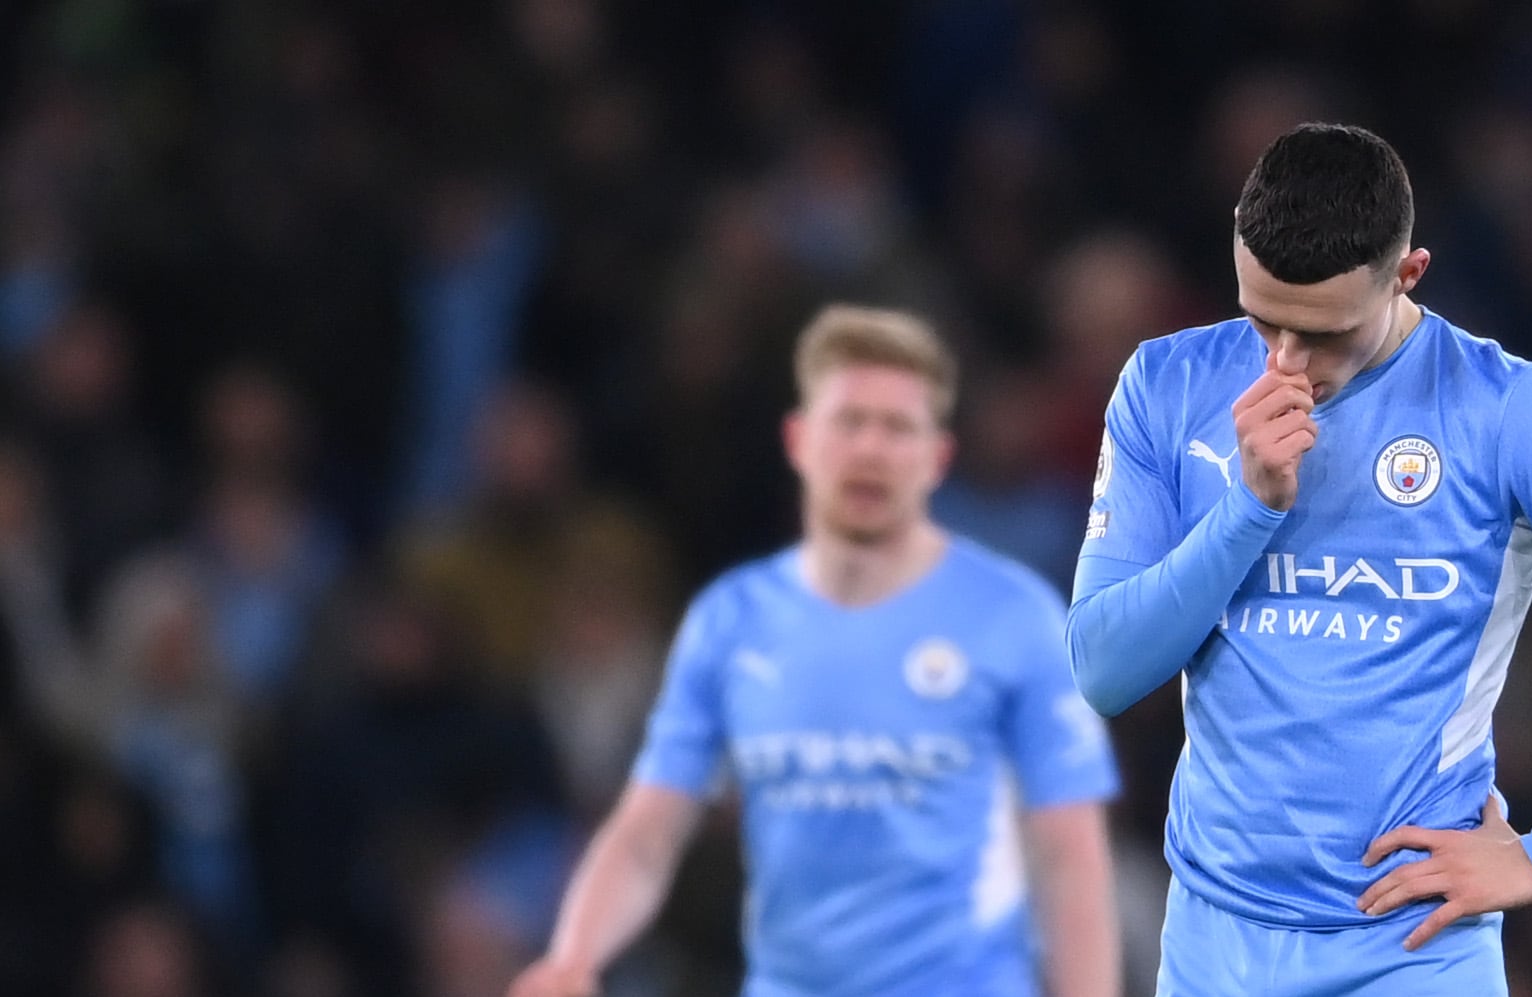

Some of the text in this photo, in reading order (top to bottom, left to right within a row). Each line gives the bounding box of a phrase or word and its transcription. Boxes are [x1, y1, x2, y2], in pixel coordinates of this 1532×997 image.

[1383, 440, 1437, 463] MANCHESTER
[1396, 494, 1417, 502] CITY
[1267, 553, 1460, 601] IHAD
